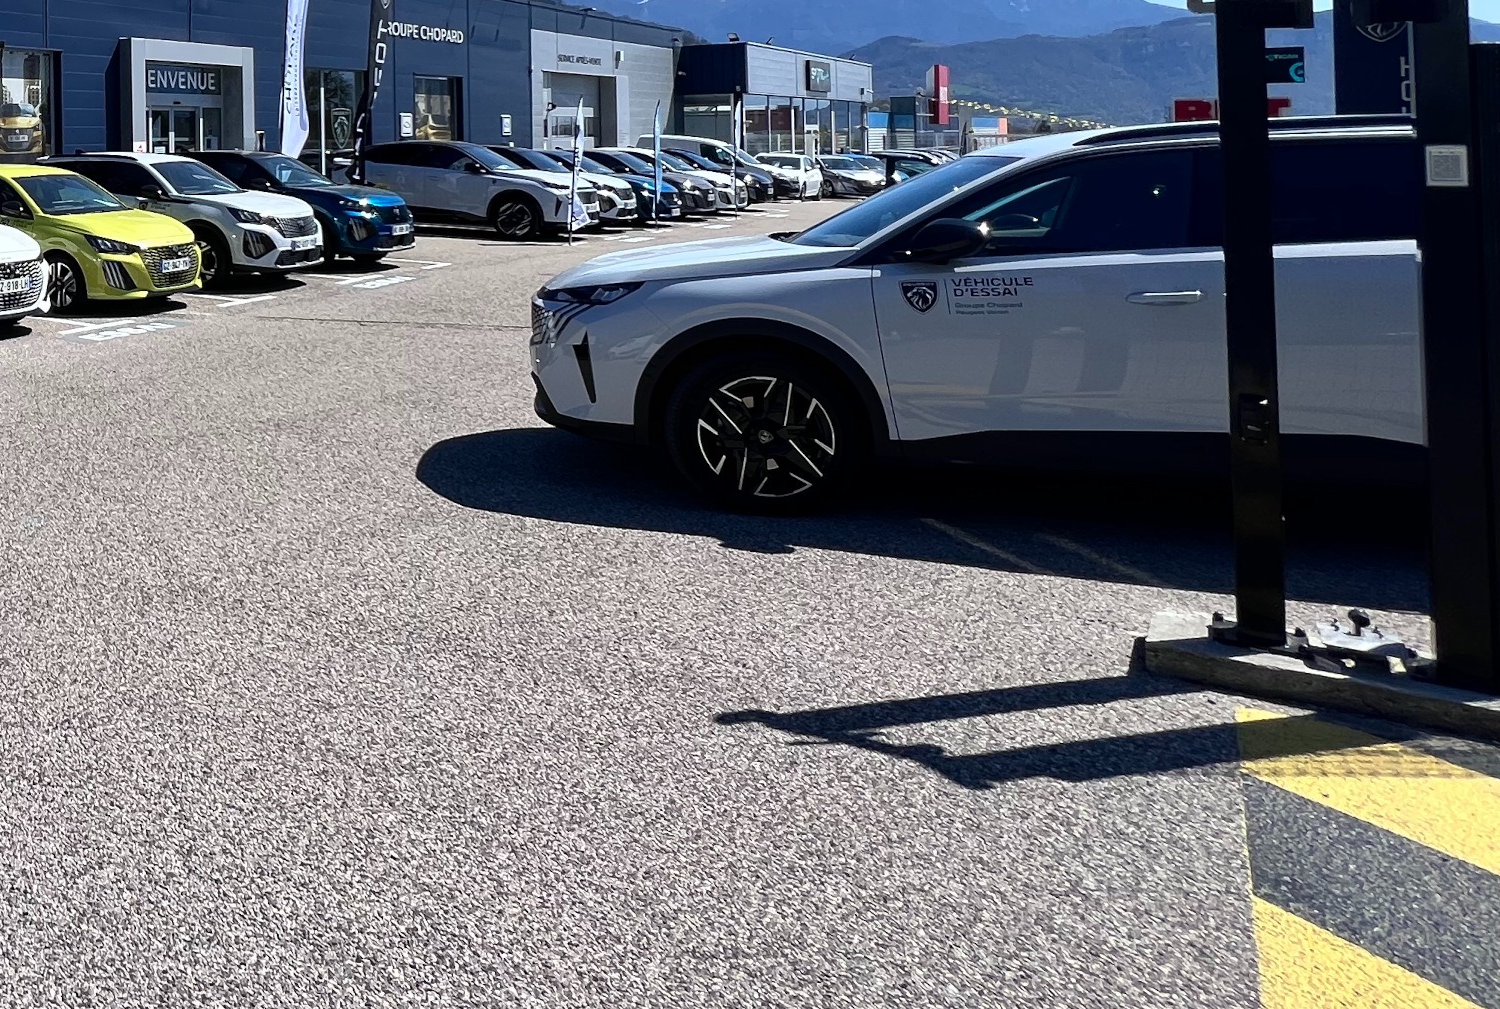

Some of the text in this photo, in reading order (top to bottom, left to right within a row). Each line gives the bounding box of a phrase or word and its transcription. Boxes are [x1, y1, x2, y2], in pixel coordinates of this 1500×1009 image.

[388, 21, 464, 44] ROUPE CHOPARD
[147, 69, 216, 90] ENVENUE
[951, 276, 1034, 287] VÉHICULE
[953, 288, 1018, 297] D'ESSAI
